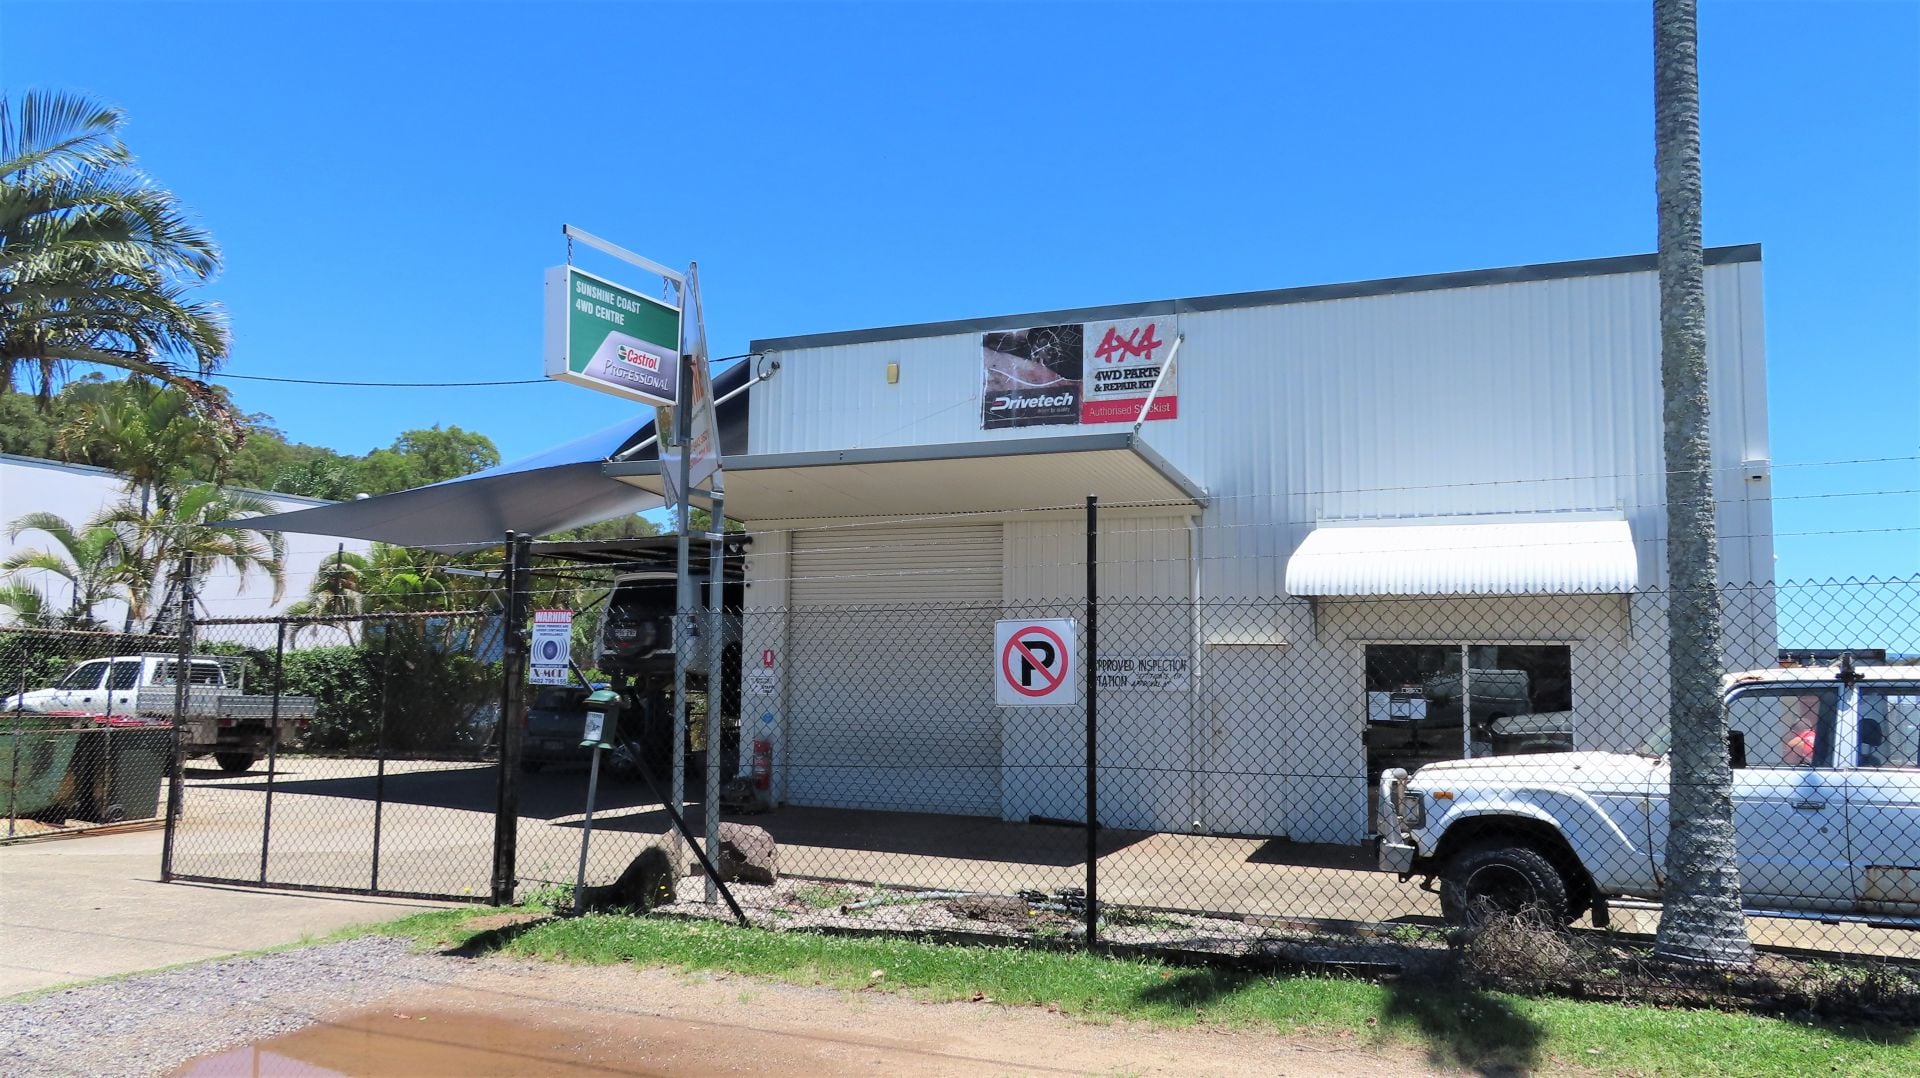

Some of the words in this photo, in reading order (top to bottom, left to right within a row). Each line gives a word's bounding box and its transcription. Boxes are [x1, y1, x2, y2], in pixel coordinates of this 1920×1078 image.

[575, 280, 615, 306] SUNSHINE
[616, 295, 641, 315] COAST
[575, 298, 594, 315] 4WD
[595, 305, 625, 326] CENTRE
[627, 349, 658, 370] Castrol
[1094, 370, 1122, 381] 4WD
[1123, 366, 1161, 379] PARTS
[1094, 383, 1103, 392] &
[1103, 381, 1138, 391] REPAIR
[990, 392, 1074, 411] Drivetech
[1089, 404, 1132, 417] Authorised
[1134, 402, 1171, 414] Stckist
[535, 611, 572, 623] WARNING
[1096, 659, 1135, 672] PPROVED
[1138, 659, 1187, 672] INSPECTION
[1096, 675, 1128, 688] TATION
